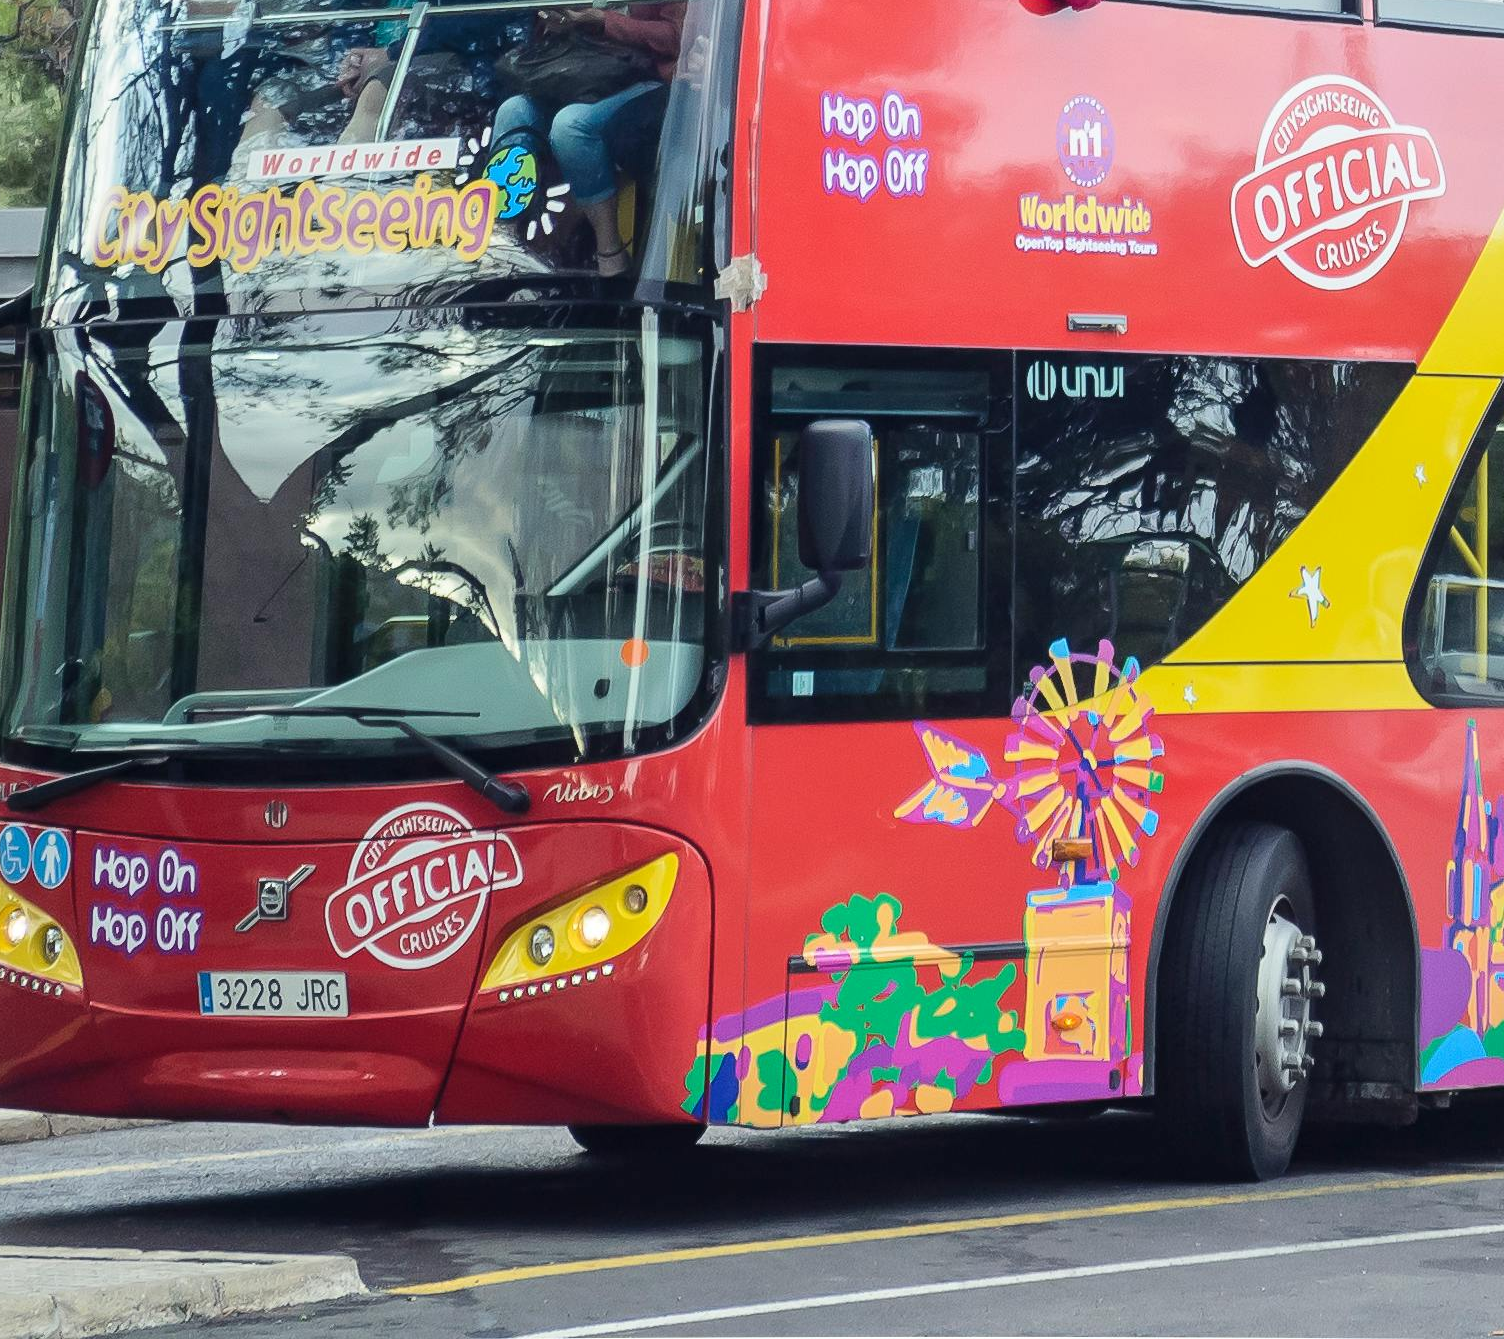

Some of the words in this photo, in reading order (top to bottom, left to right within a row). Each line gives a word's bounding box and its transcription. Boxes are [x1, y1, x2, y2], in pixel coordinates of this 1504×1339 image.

[822, 95, 877, 142] Hop
[883, 93, 920, 137] On
[1273, 90, 1380, 155] CITYSIGHTSEEING
[261, 145, 443, 176] Worldwide
[824, 152, 879, 199] Hop
[886, 149, 927, 194] Off
[1019, 194, 1151, 234] Worldwide
[1254, 138, 1431, 243] OFFICIAL
[1065, 236, 1126, 255] Sightseeing
[1128, 240, 1158, 255] Tours
[1315, 220, 1387, 271] CRUISES
[94, 848, 150, 897] Hop
[158, 849, 196, 894] On
[345, 844, 508, 938] OFFICIAL
[91, 906, 147, 953] Hop
[156, 907, 202, 951] Off
[398, 911, 465, 955] CRUISES
[217, 978, 283, 1011] 3228
[296, 979, 341, 1011] JRG
